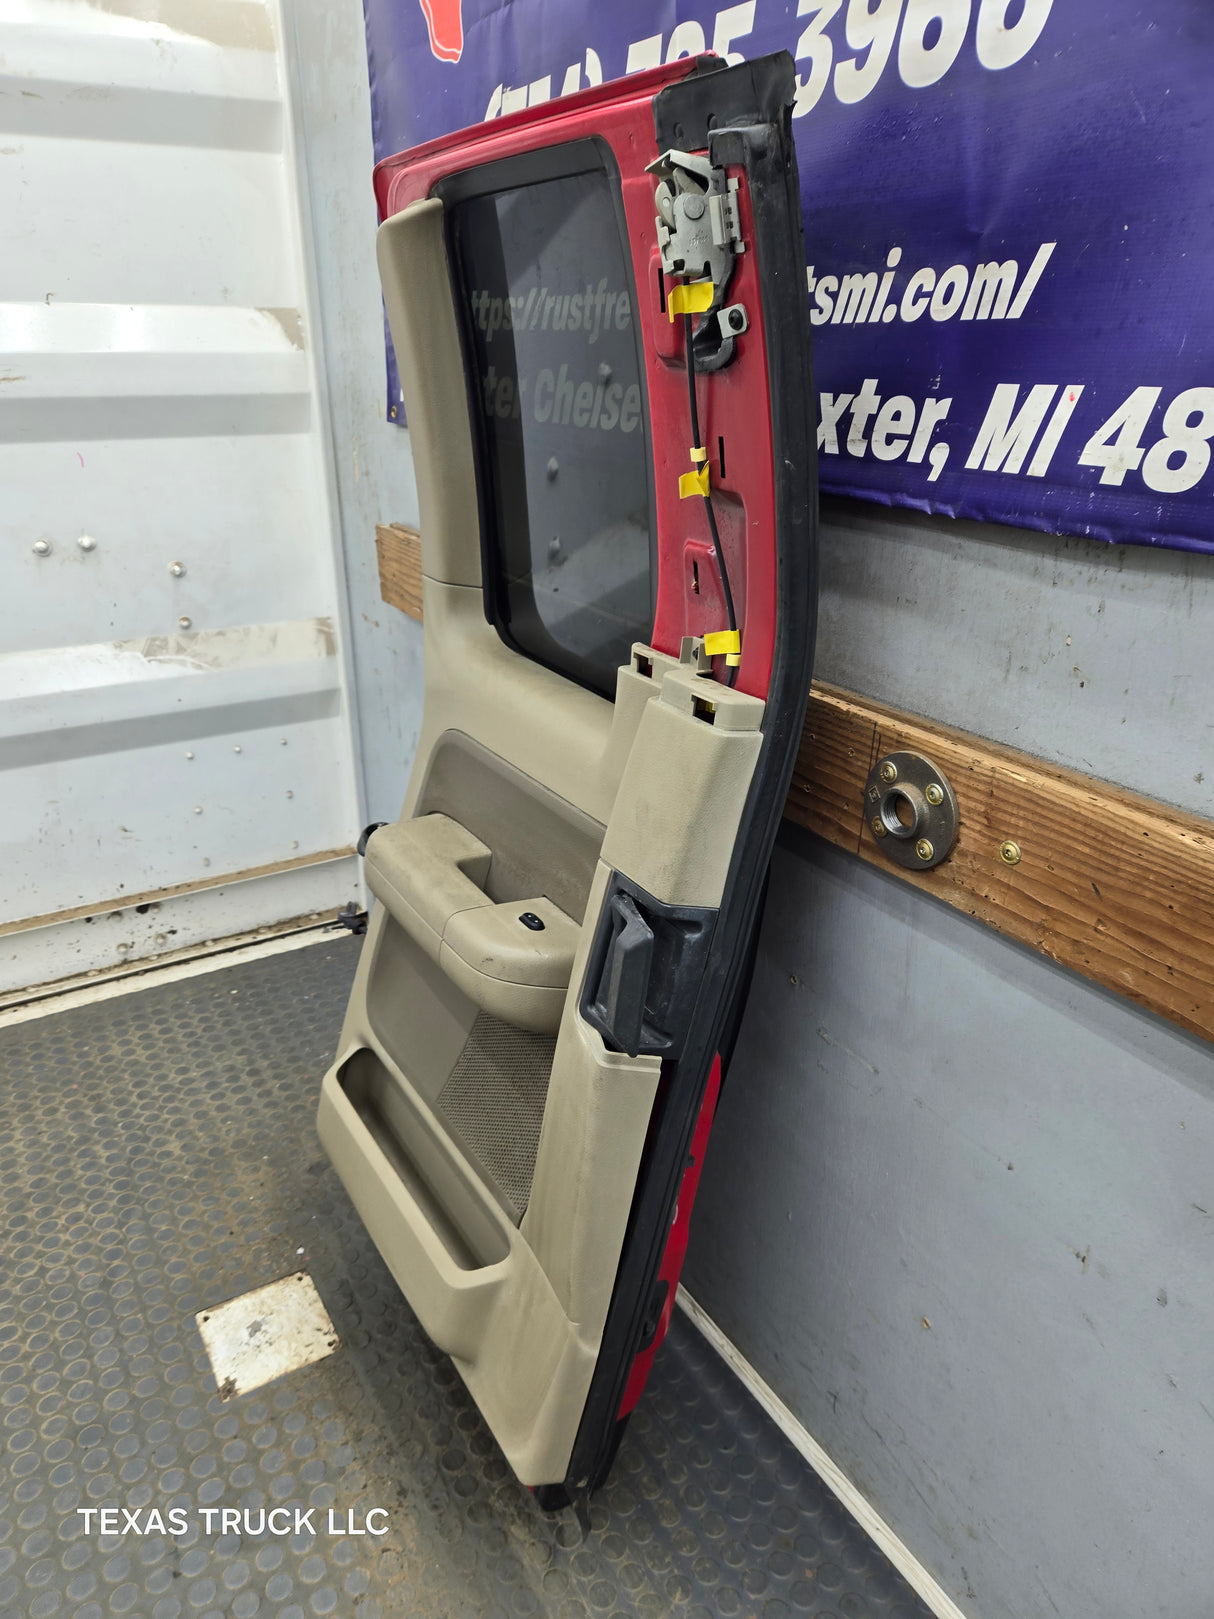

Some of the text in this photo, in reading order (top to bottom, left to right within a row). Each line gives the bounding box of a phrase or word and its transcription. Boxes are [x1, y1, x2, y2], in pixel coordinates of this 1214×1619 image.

[534, 363, 643, 433] Chelse
[964, 383, 1085, 477] MI
[1078, 386, 1214, 493] 48
